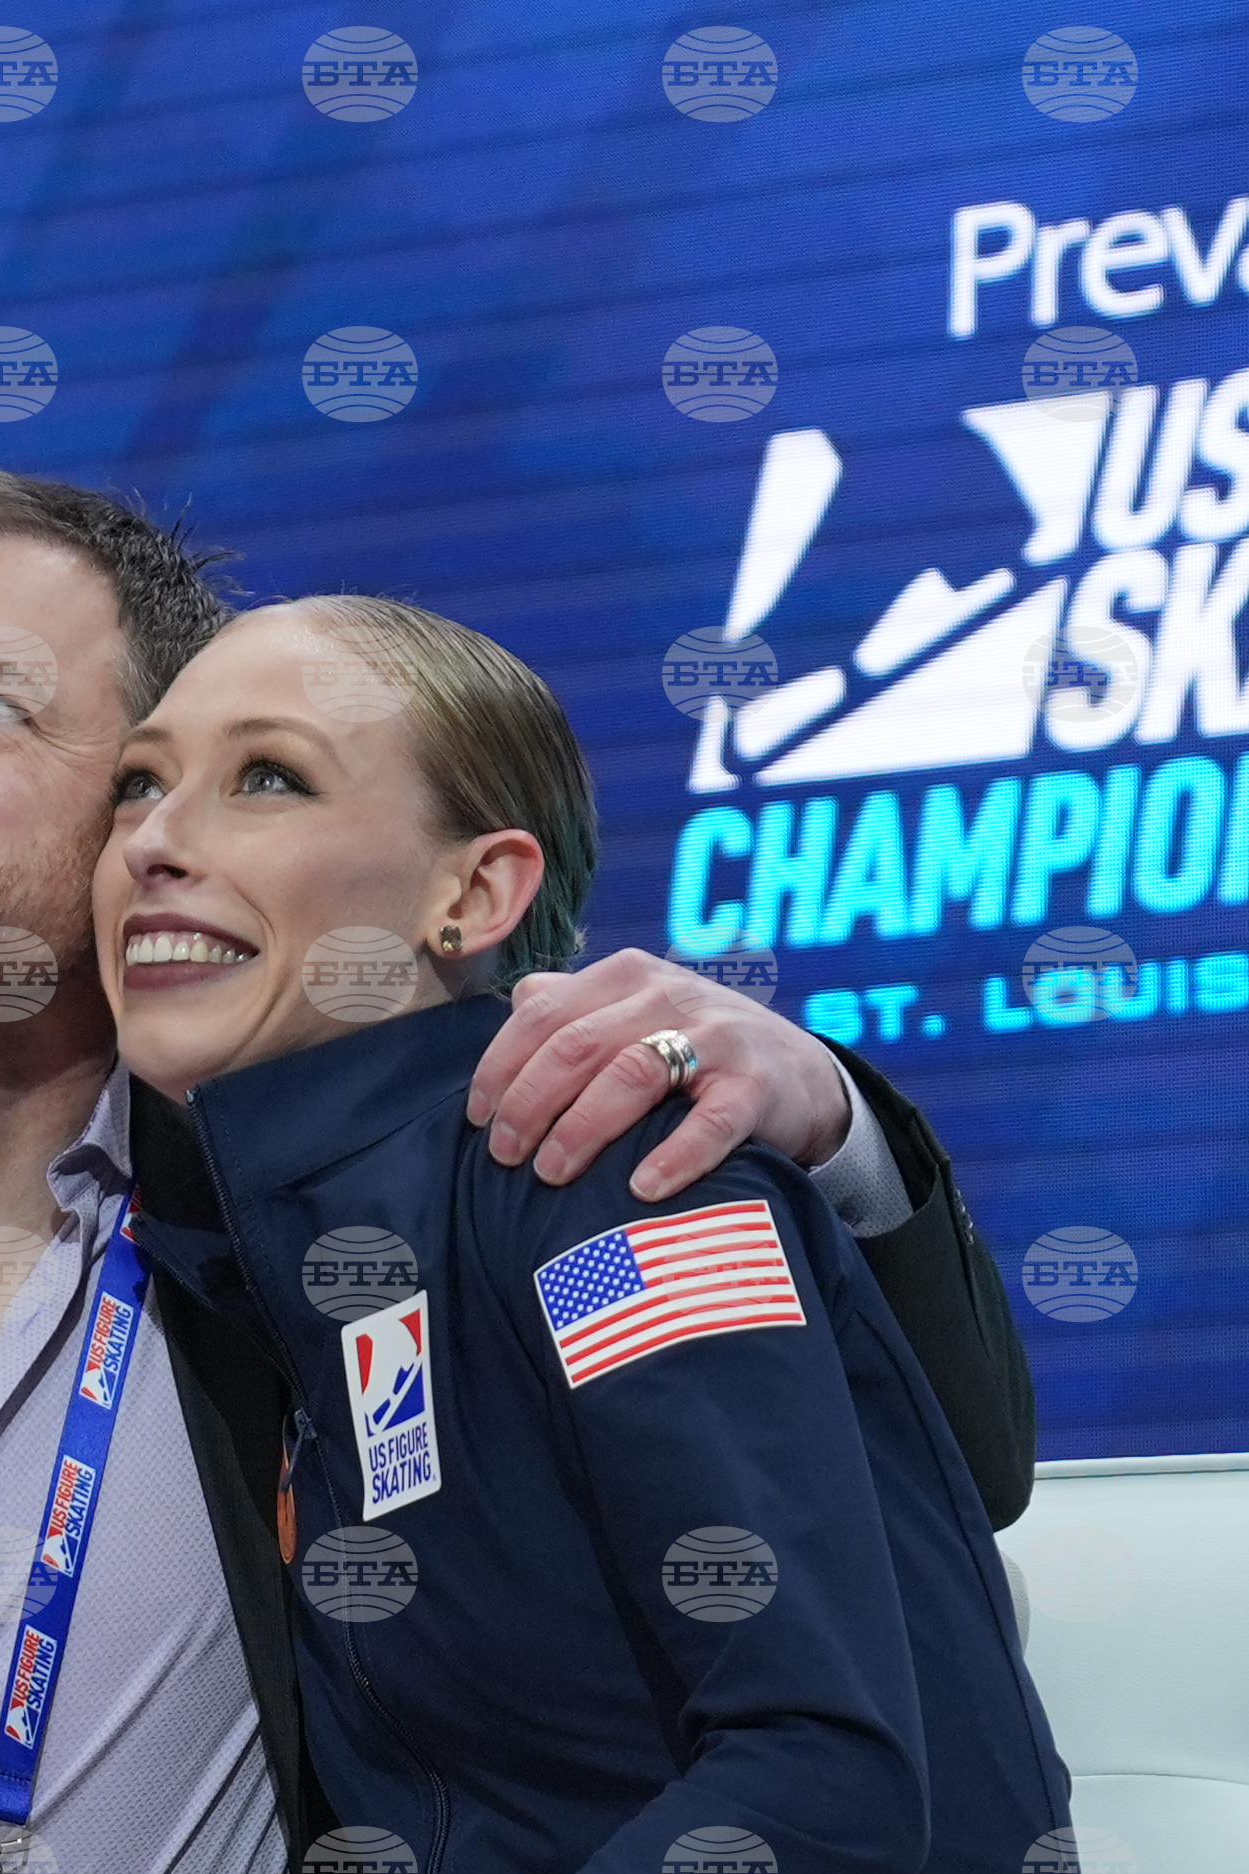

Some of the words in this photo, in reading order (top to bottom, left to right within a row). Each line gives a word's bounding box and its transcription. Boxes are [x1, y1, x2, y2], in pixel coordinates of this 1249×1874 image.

[948, 197, 1249, 341] Prev
[803, 984, 947, 1046] ST.
[982, 951, 1249, 1034] LOUIS
[94, 1297, 117, 1344] FIGURE
[103, 1305, 131, 1373] SKATING
[89, 1343, 104, 1365] US
[369, 1442, 386, 1472] US
[388, 1421, 428, 1464] FIGURE
[55, 1460, 78, 1510] FIGURE
[65, 1467, 93, 1537] SKATING
[372, 1450, 431, 1504] SKATING
[51, 1508, 67, 1529] US
[18, 1630, 41, 1681] FIGURE
[27, 1639, 55, 1709] SKATING
[13, 1680, 29, 1701] US
